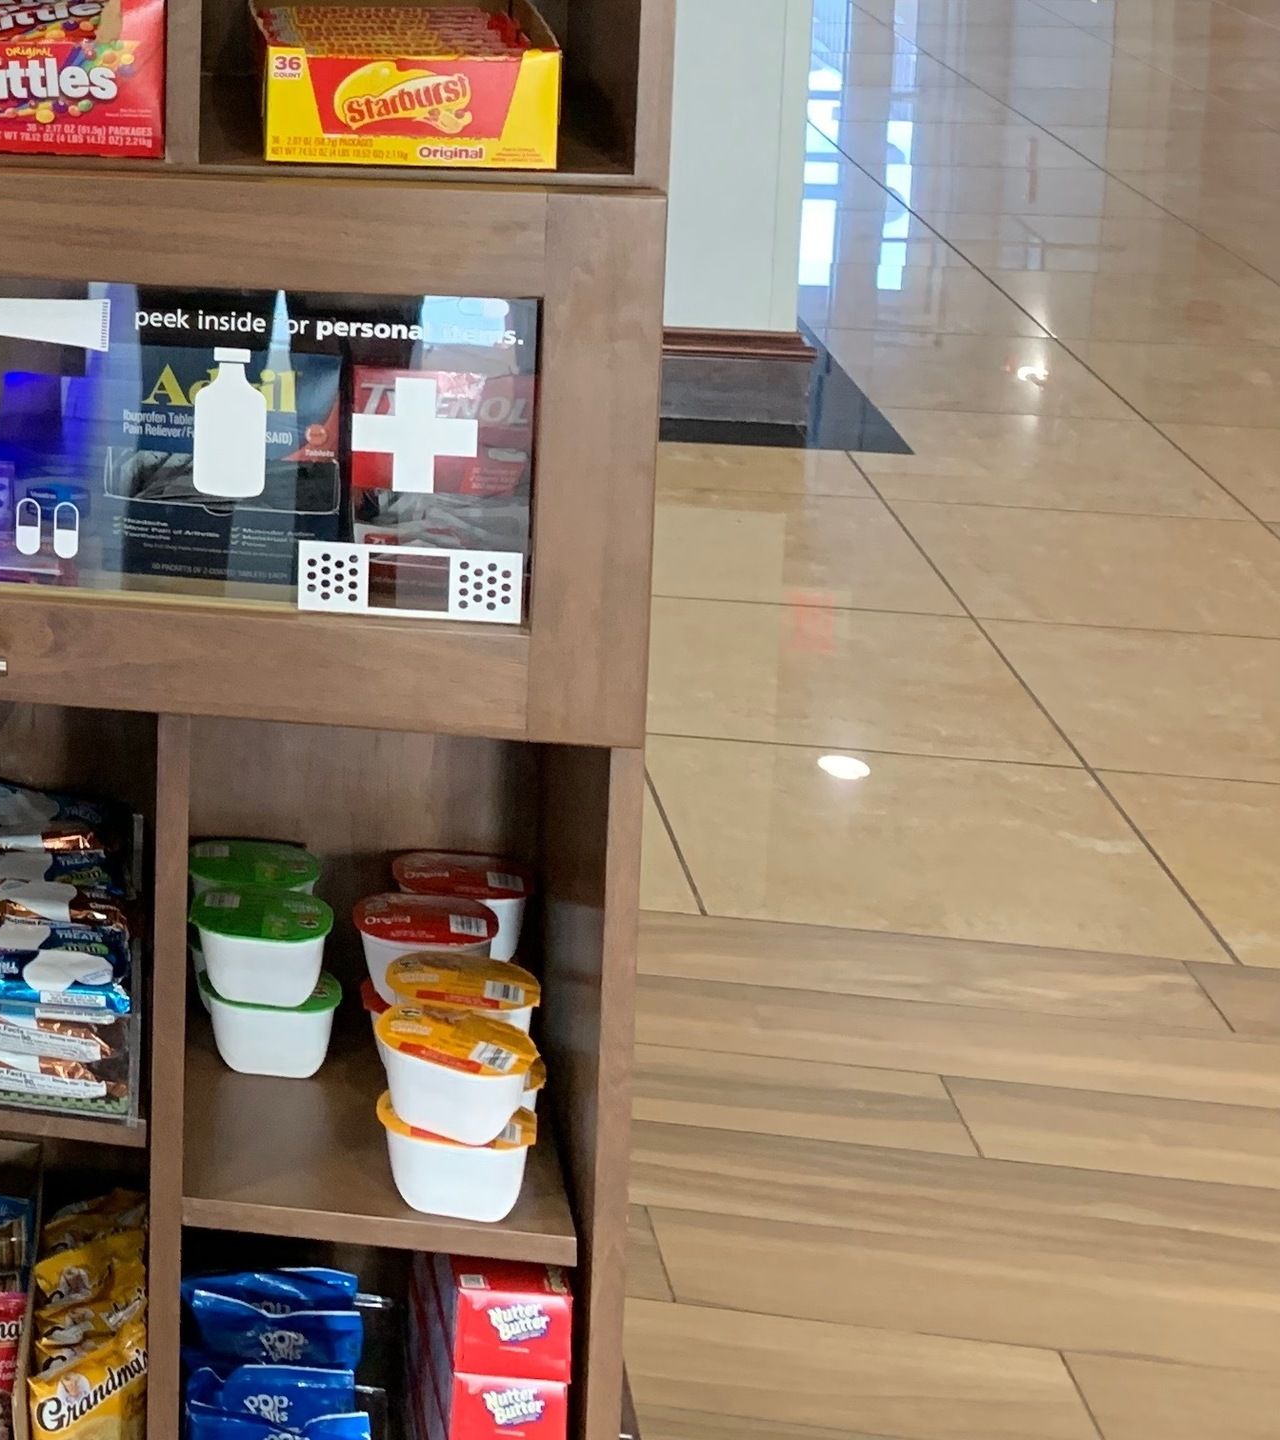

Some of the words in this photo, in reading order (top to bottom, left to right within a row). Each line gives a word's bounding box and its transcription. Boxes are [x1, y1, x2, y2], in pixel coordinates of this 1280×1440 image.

[274, 55, 301, 71] 36
[346, 73, 469, 124] Starburst
[4, 131, 18, 141] WT
[108, 126, 153, 136] PACKAGES
[418, 146, 484, 160] Original
[135, 309, 189, 330] peek
[198, 310, 266, 334] inside
[142, 363, 297, 414] Adil
[123, 409, 166, 426] Ibuprofen
[123, 423, 143, 436] Pain
[487, 1303, 544, 1324] Nutter
[498, 1315, 551, 1341] Butter
[36, 1346, 148, 1433] Grandma's
[482, 1387, 538, 1408] Nutter
[494, 1399, 545, 1425] Butter
